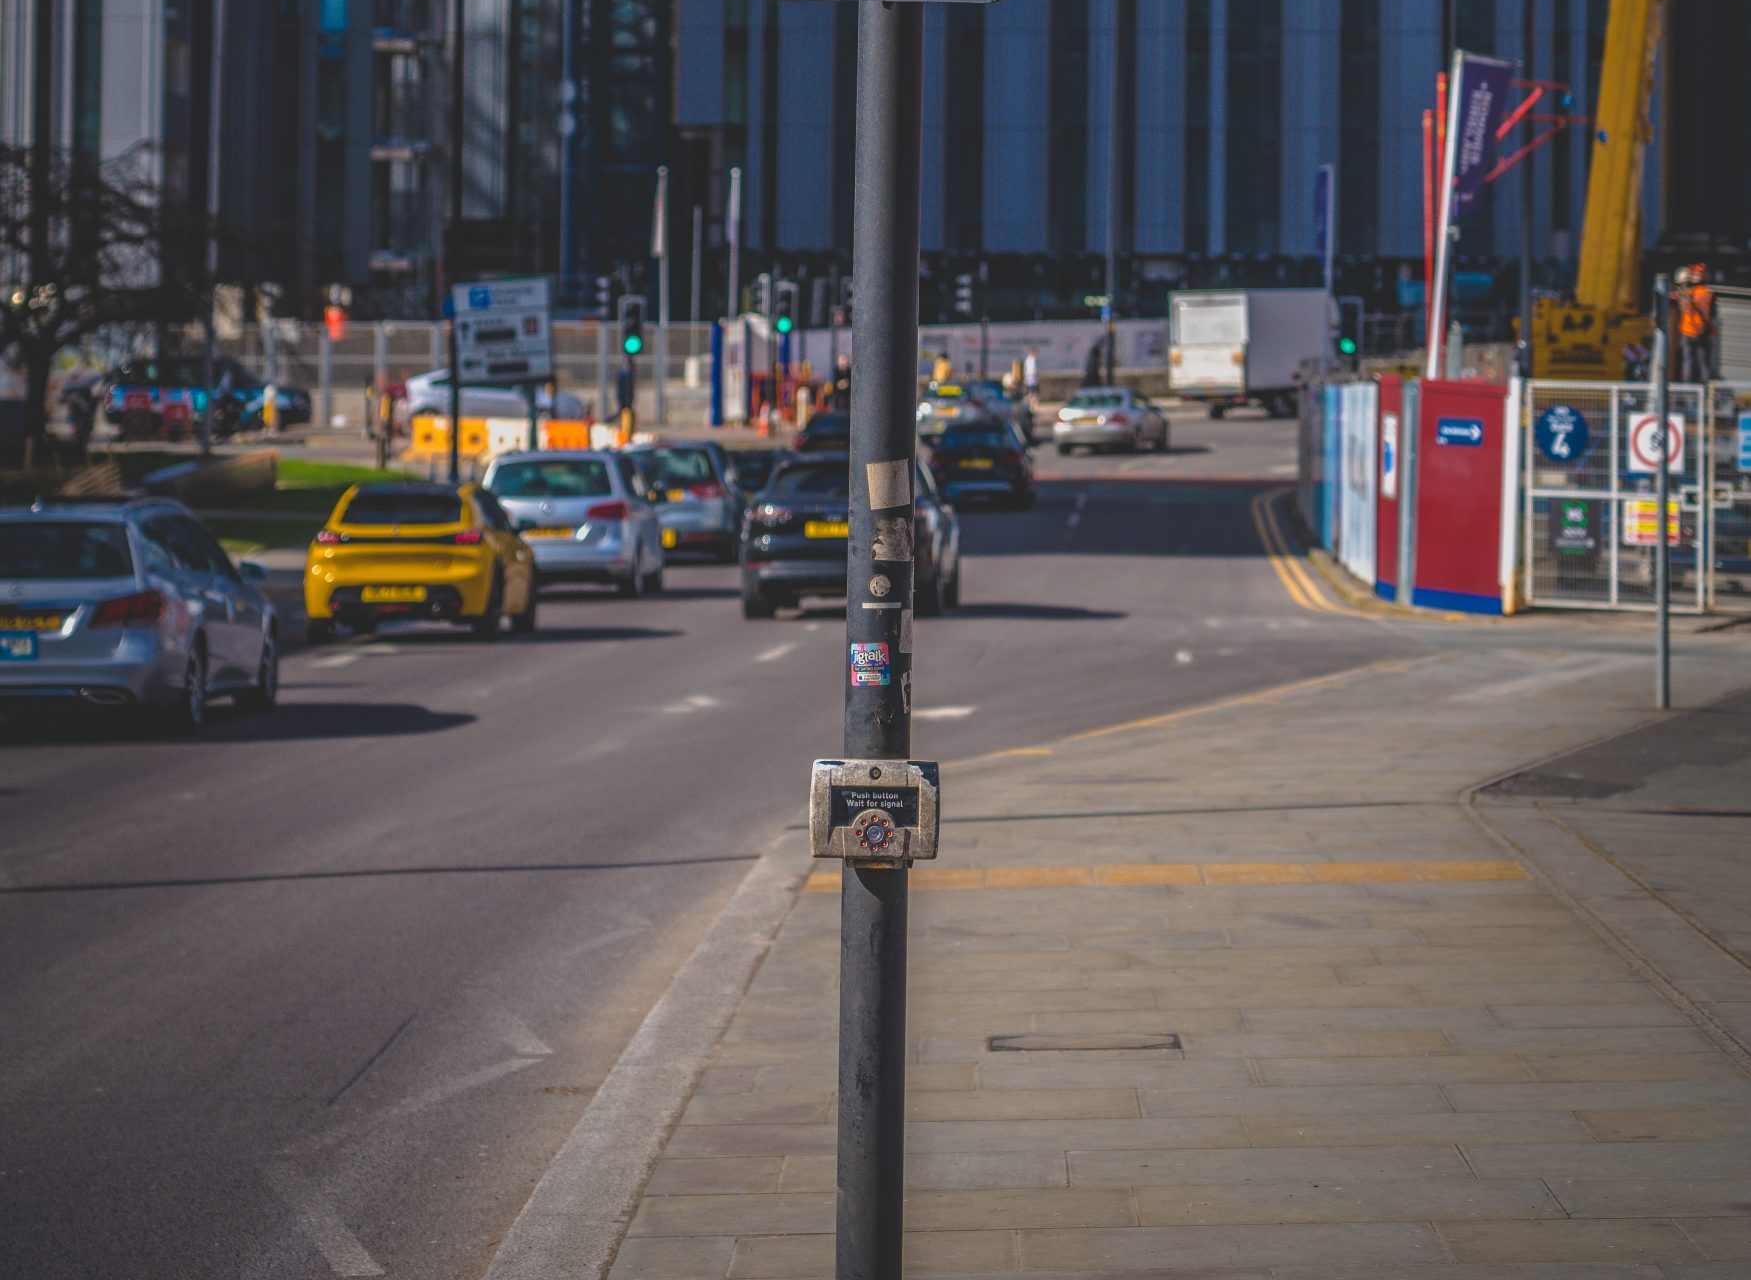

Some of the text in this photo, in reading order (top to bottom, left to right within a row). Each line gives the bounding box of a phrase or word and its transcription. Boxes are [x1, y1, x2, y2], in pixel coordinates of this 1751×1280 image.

[1551, 431, 1570, 458] 4
[853, 650, 886, 665] jigtalk
[851, 791, 899, 799] Push button
[846, 799, 904, 809] Wait for signal
